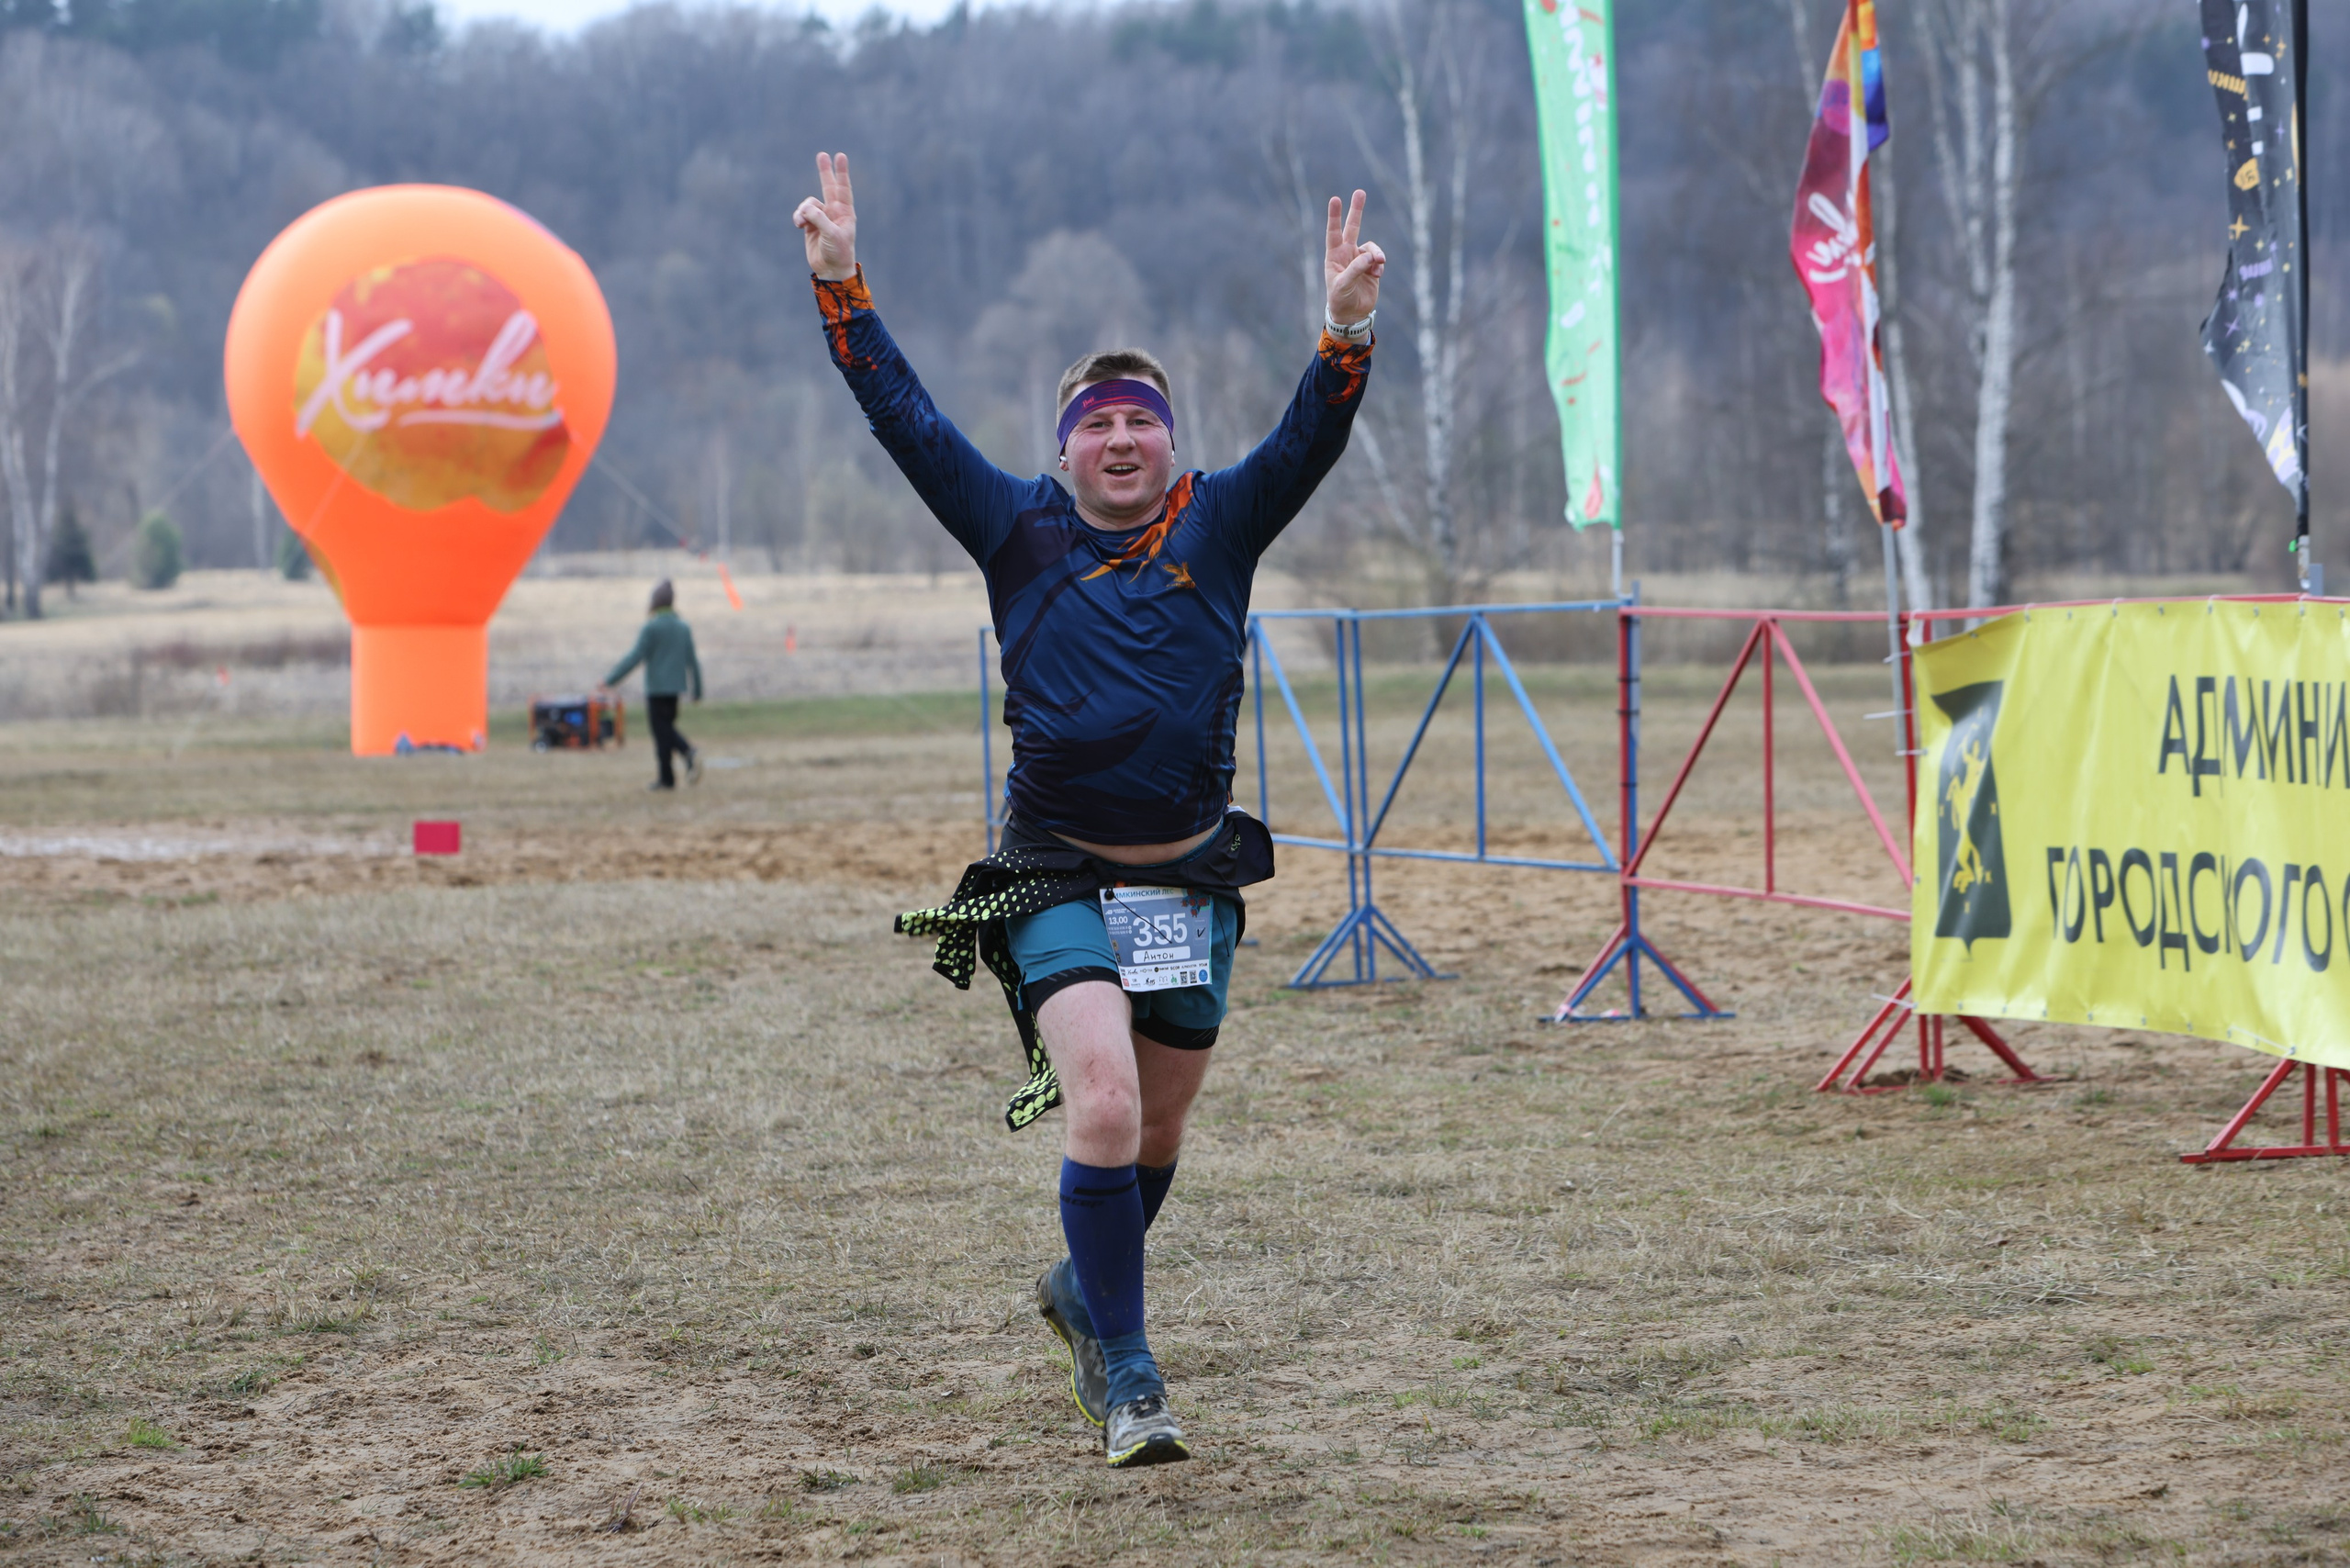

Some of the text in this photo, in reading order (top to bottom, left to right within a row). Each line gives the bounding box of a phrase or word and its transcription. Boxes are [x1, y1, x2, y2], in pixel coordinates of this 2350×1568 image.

[295, 308, 563, 438] Химки
[1113, 888, 1174, 899] ИМКИНСКИЙ ЛЕС
[2046, 846, 2333, 972] ГОРОДСКОГО
[1108, 916, 1128, 925] 13,00
[1133, 913, 1188, 946] 355
